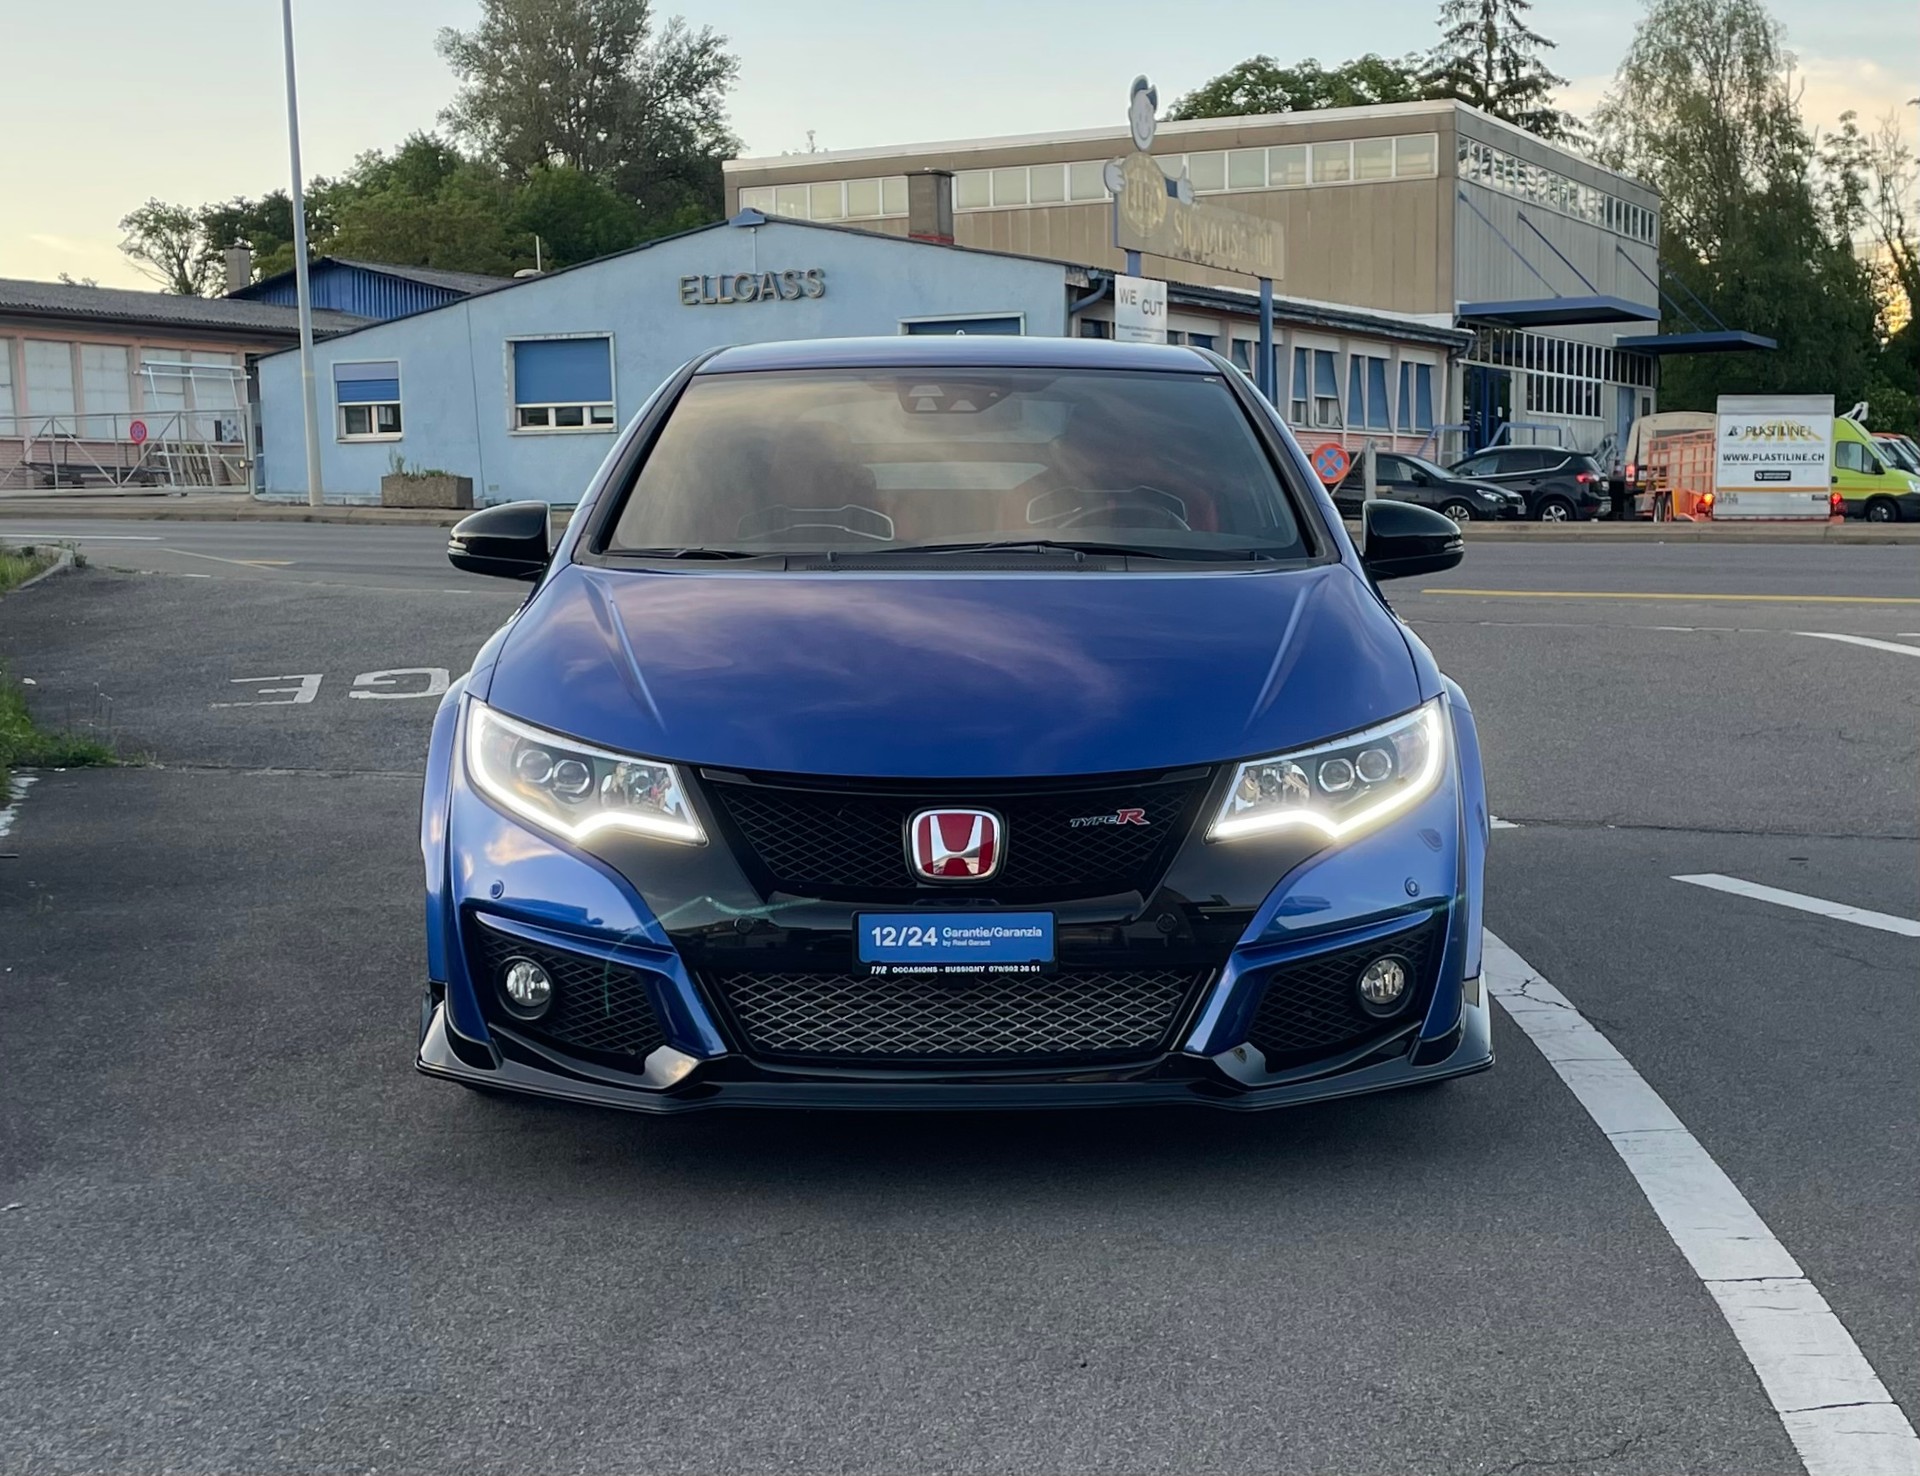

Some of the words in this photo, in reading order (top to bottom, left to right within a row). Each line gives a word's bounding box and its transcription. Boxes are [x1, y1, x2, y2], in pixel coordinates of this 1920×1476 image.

[679, 268, 826, 305] ELLGASS
[1119, 287, 1138, 306] WE
[1141, 298, 1164, 317] CUT
[1723, 453, 1825, 461] WWW.PLASTILINE.CH
[1070, 815, 1117, 828] TYPE
[1116, 808, 1151, 826] R
[871, 926, 938, 946] 12/24
[942, 926, 1042, 938] Garantie/Garanzia
[942, 939, 951, 947] by
[945, 965, 985, 973] BUSSIGNY
[1031, 965, 1041, 973] 61
